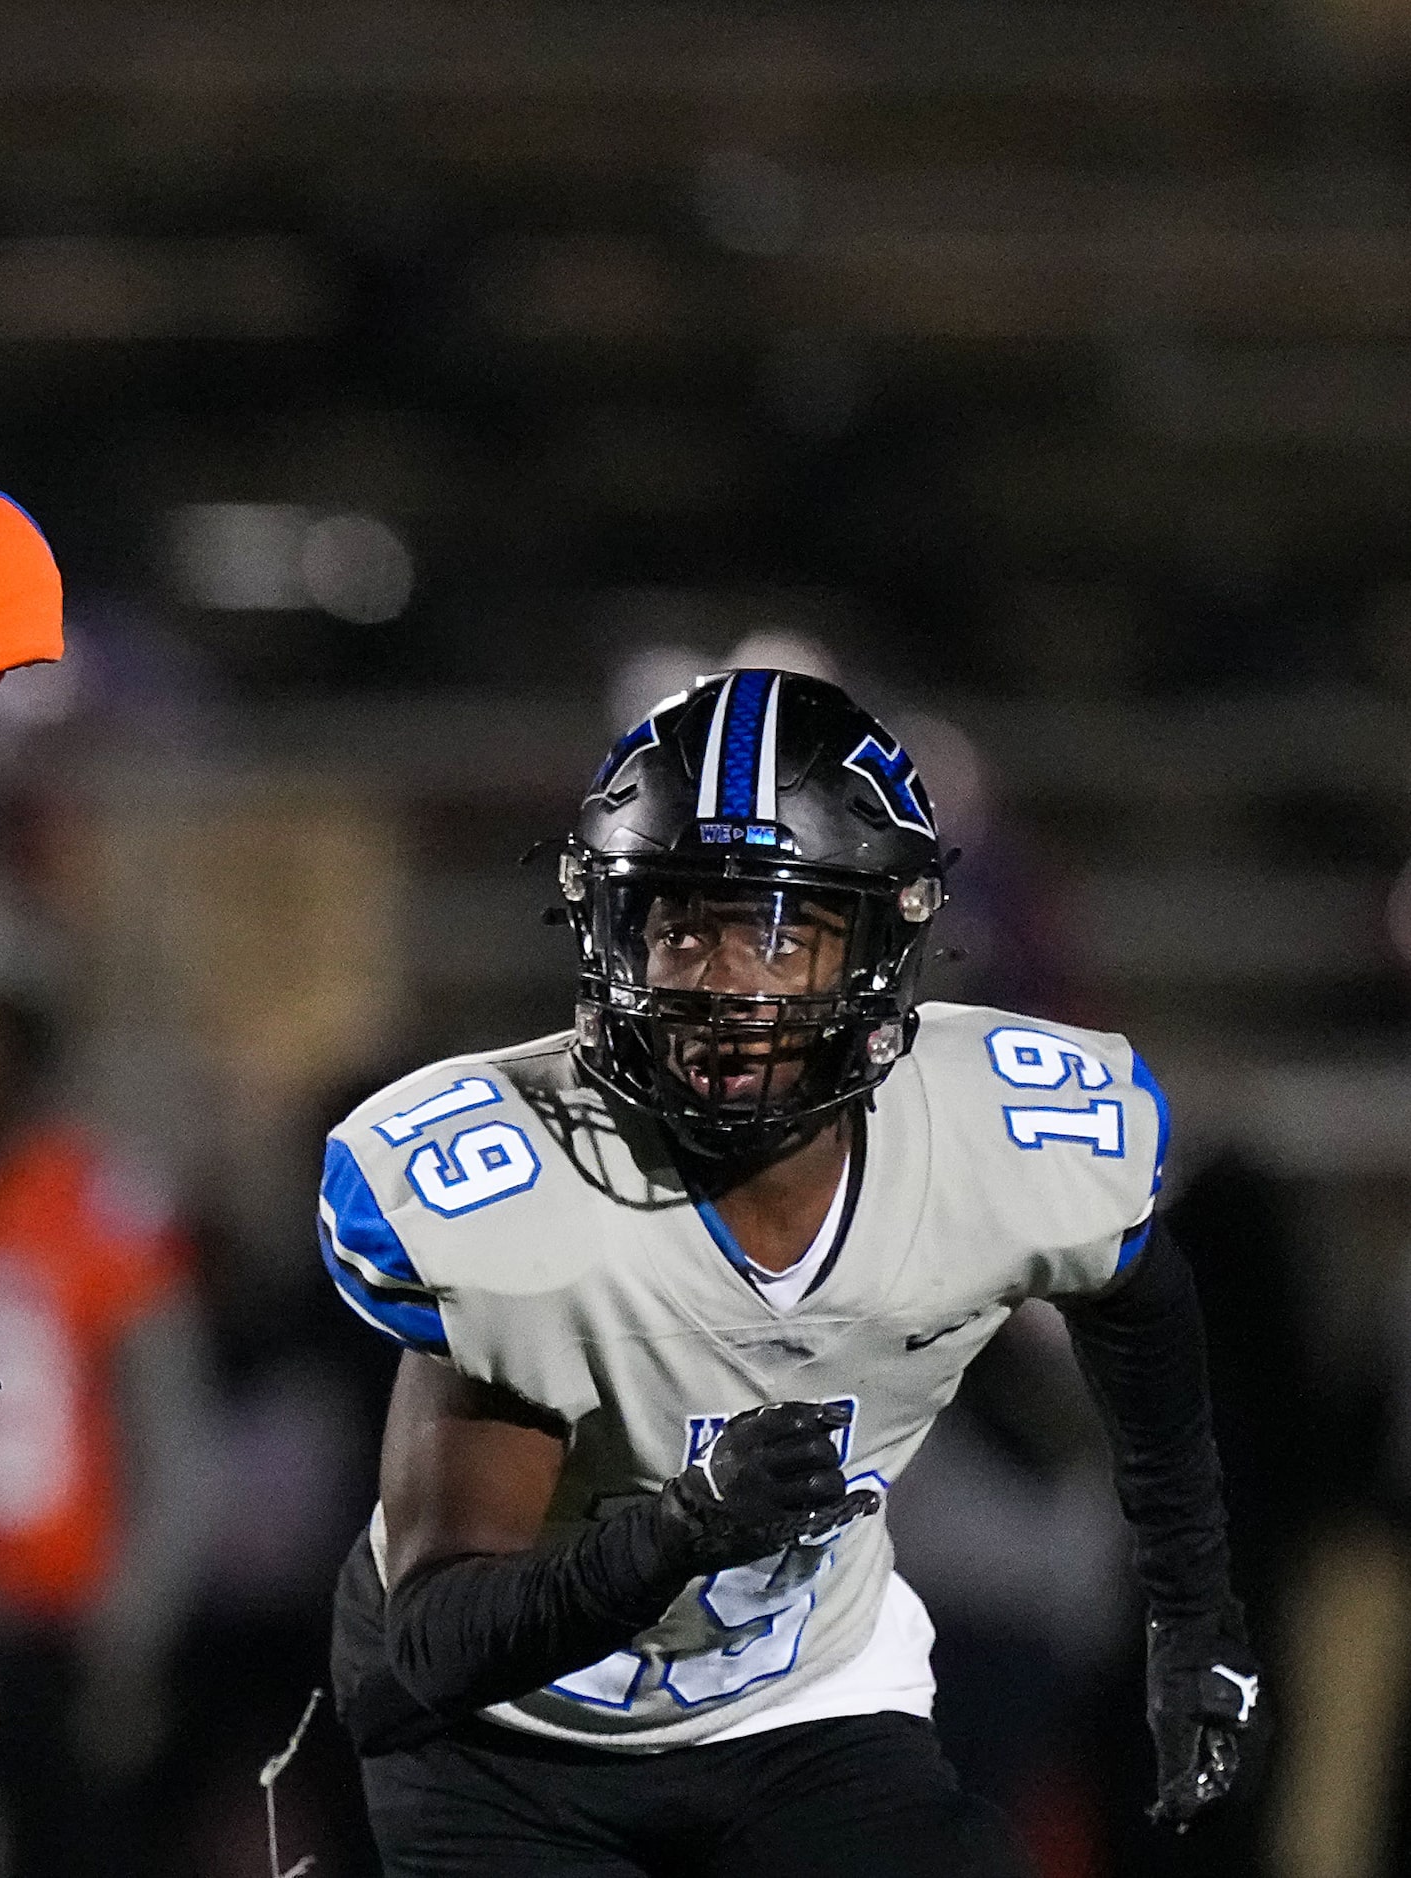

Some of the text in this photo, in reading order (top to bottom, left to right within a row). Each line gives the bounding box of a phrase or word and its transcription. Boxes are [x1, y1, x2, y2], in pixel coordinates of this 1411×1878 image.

[699, 823, 777, 846] WE ME
[370, 1076, 543, 1220] 19
[983, 1026, 1126, 1160] 19
